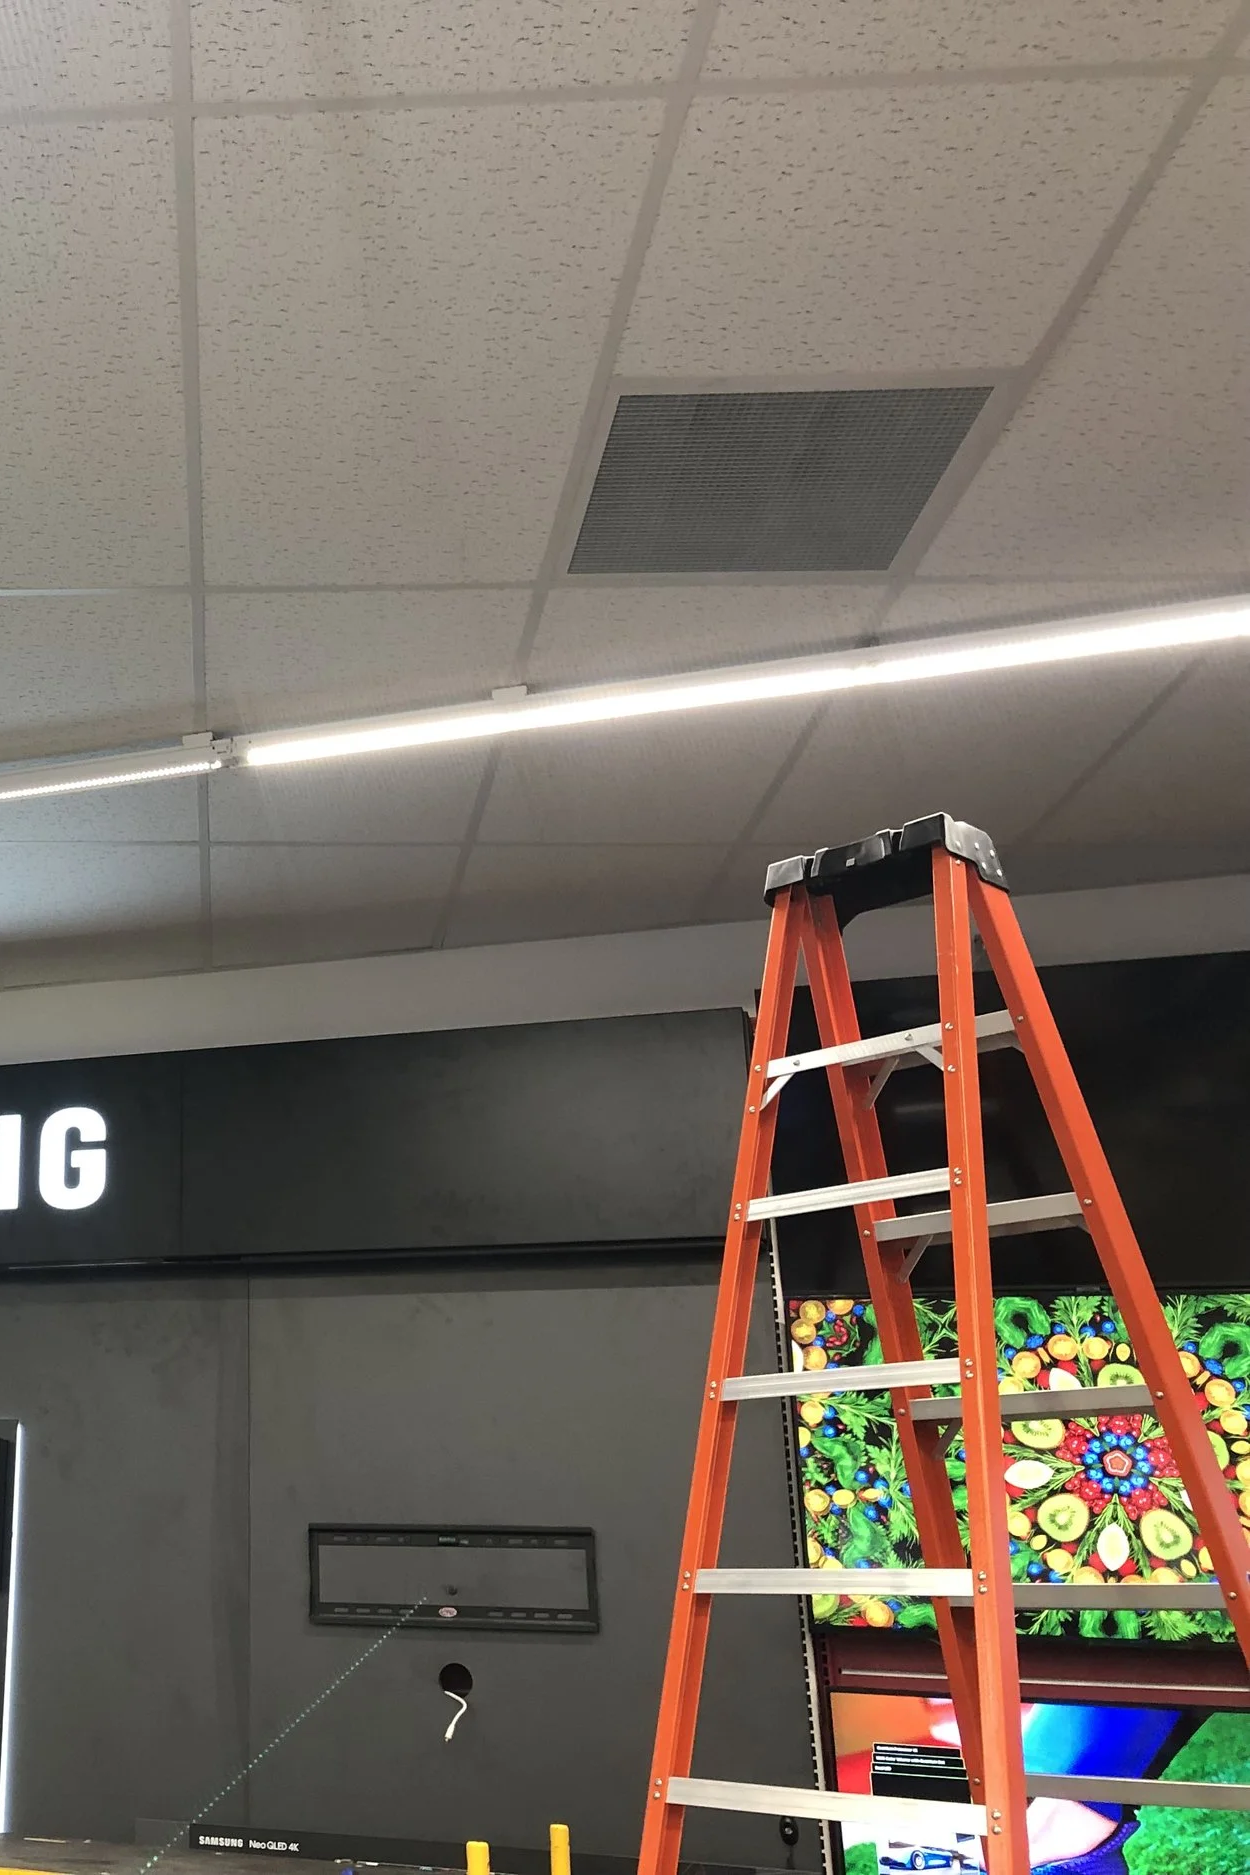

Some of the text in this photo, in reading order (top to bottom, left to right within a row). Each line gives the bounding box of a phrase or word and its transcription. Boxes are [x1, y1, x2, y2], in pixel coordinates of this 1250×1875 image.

[199, 1835, 244, 1848] SAMSUNG
[249, 1839, 266, 1850] Neo
[288, 1843, 300, 1852] 4K
